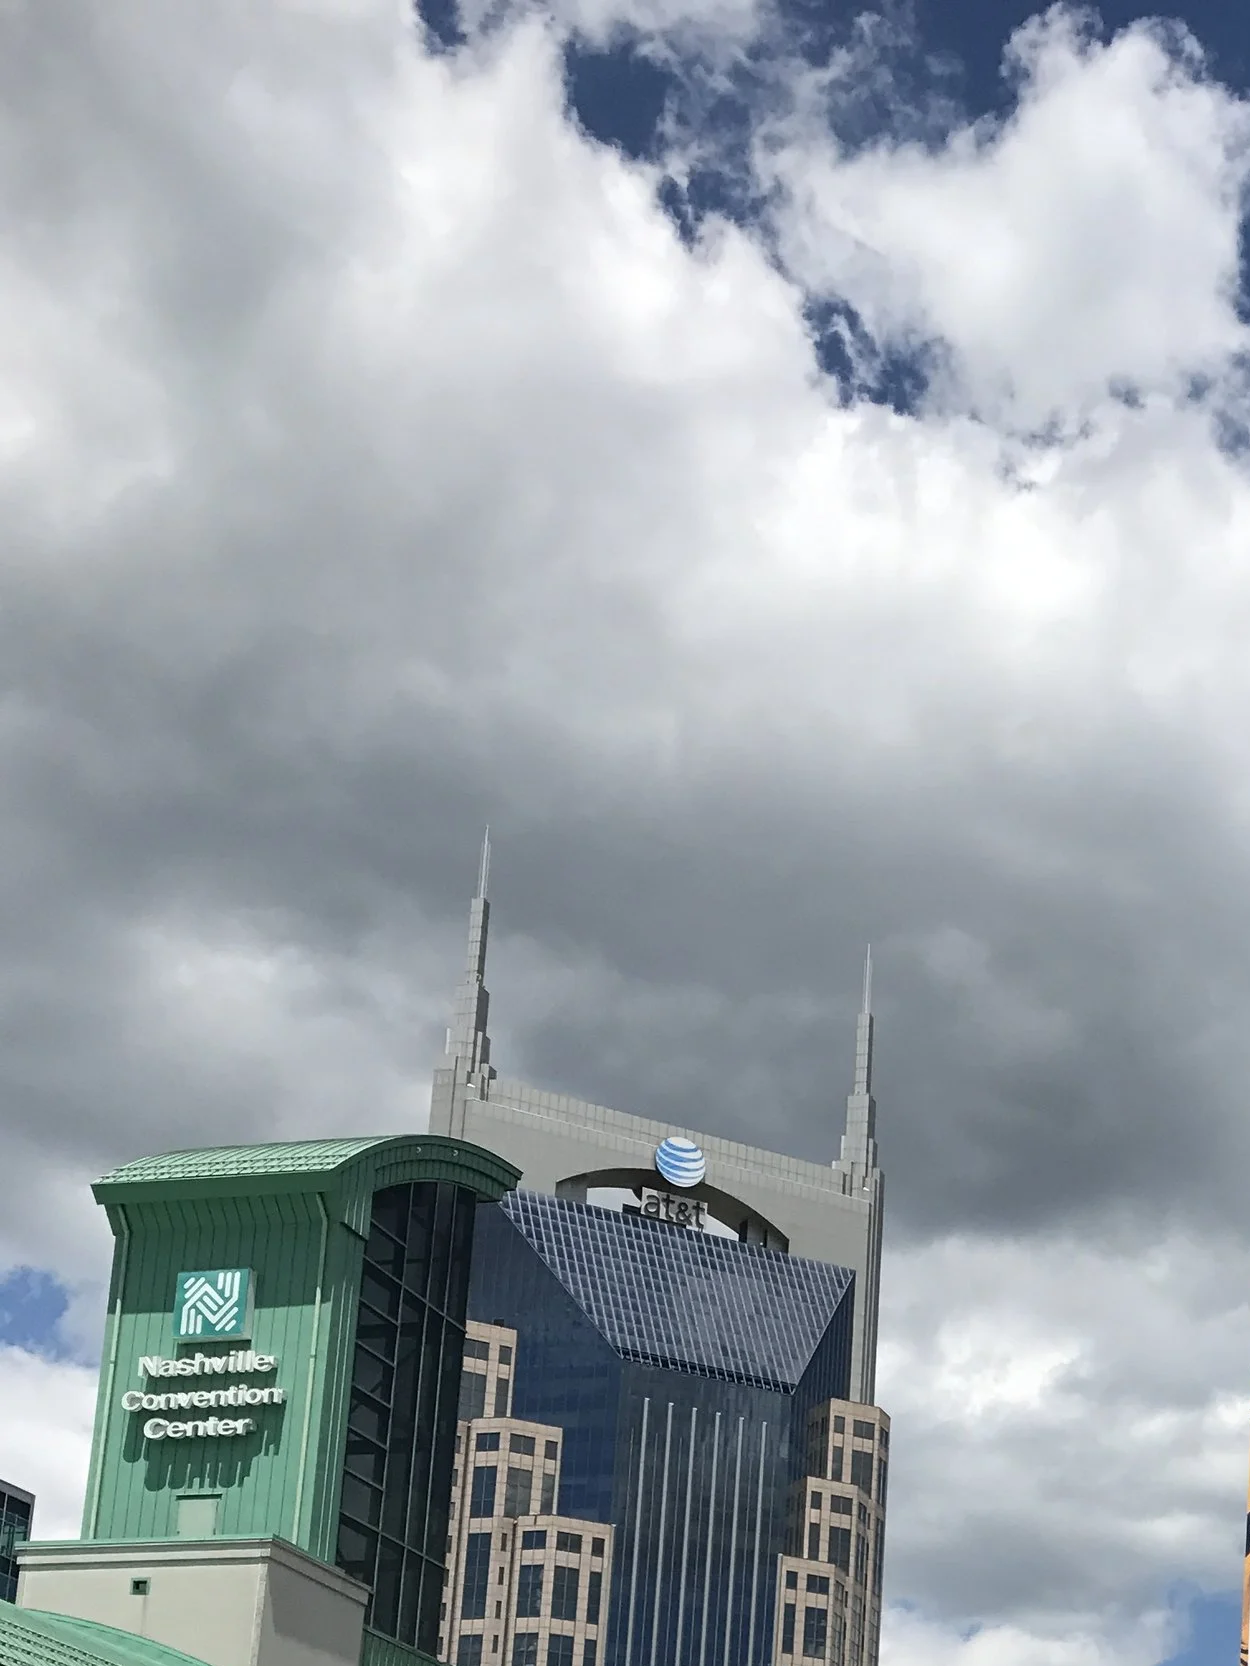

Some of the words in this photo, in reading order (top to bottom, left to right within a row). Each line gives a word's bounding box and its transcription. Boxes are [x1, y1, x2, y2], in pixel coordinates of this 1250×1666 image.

[644, 1194, 705, 1230] at&t
[138, 1350, 277, 1378] Nashville
[121, 1384, 285, 1412] Convention
[144, 1416, 256, 1440] Center
